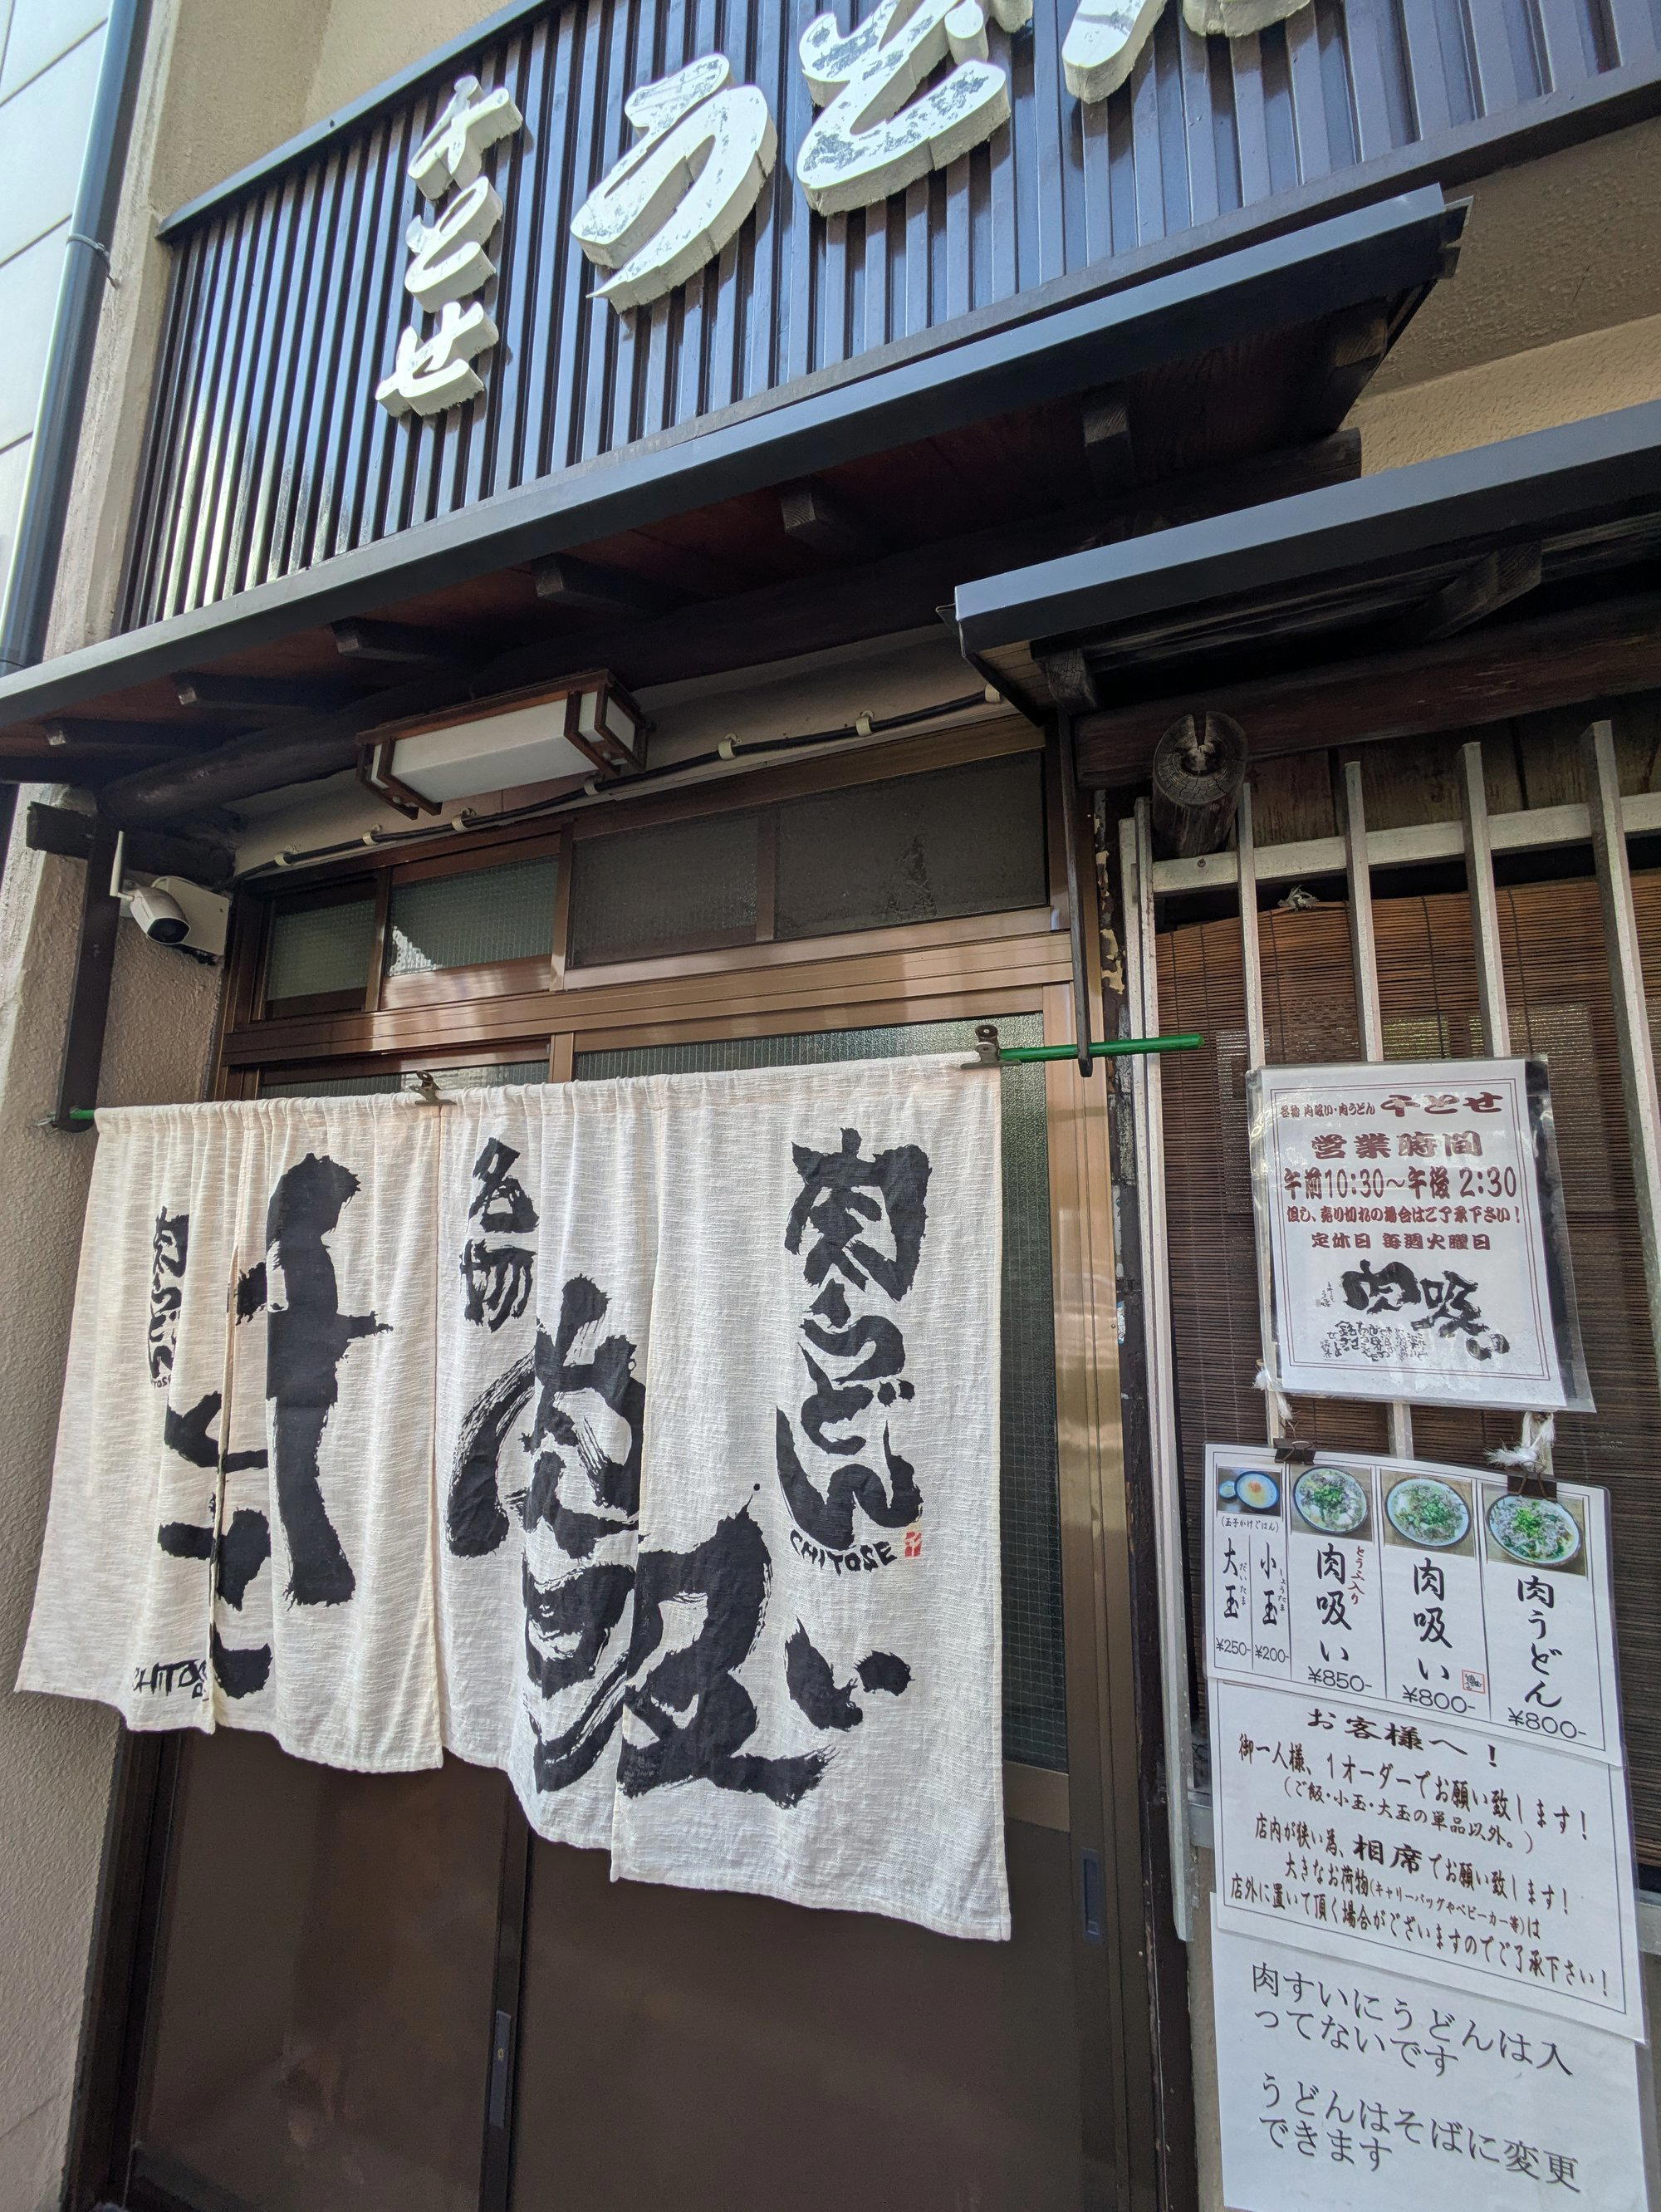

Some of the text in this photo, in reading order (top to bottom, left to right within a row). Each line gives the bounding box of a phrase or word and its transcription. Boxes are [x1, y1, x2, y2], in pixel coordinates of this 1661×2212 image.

[375, 73, 524, 418] 千とせ
[1311, 1131, 1483, 1160] 営業時間
[1380, 1091, 1502, 1117] 千とせ
[1311, 1233, 1492, 1250] 定休日 毎週火曜日
[777, 1127, 933, 1551] 肉うどん
[790, 1529, 898, 1576] CHITOSE
[1222, 1538, 1240, 1619] 大玉
[1260, 1542, 1278, 1626] 小玉
[1316, 1543, 1352, 1662] 肉吸い
[1413, 1557, 1453, 1681] 肉吸い
[1517, 1575, 1563, 1708] 肉うどん
[1307, 1708, 1498, 1768] お客様へ！
[1231, 1872, 1608, 1996] 店外に置いて頂く場合がございますのでご了承下さい！
[1252, 1961, 1574, 2077] 肉すいにうどんは入
[1254, 2010, 1459, 2077] ってないです
[1259, 2116, 1393, 2172] できます
[1262, 2072, 1581, 2193] うどんはそばに変更
